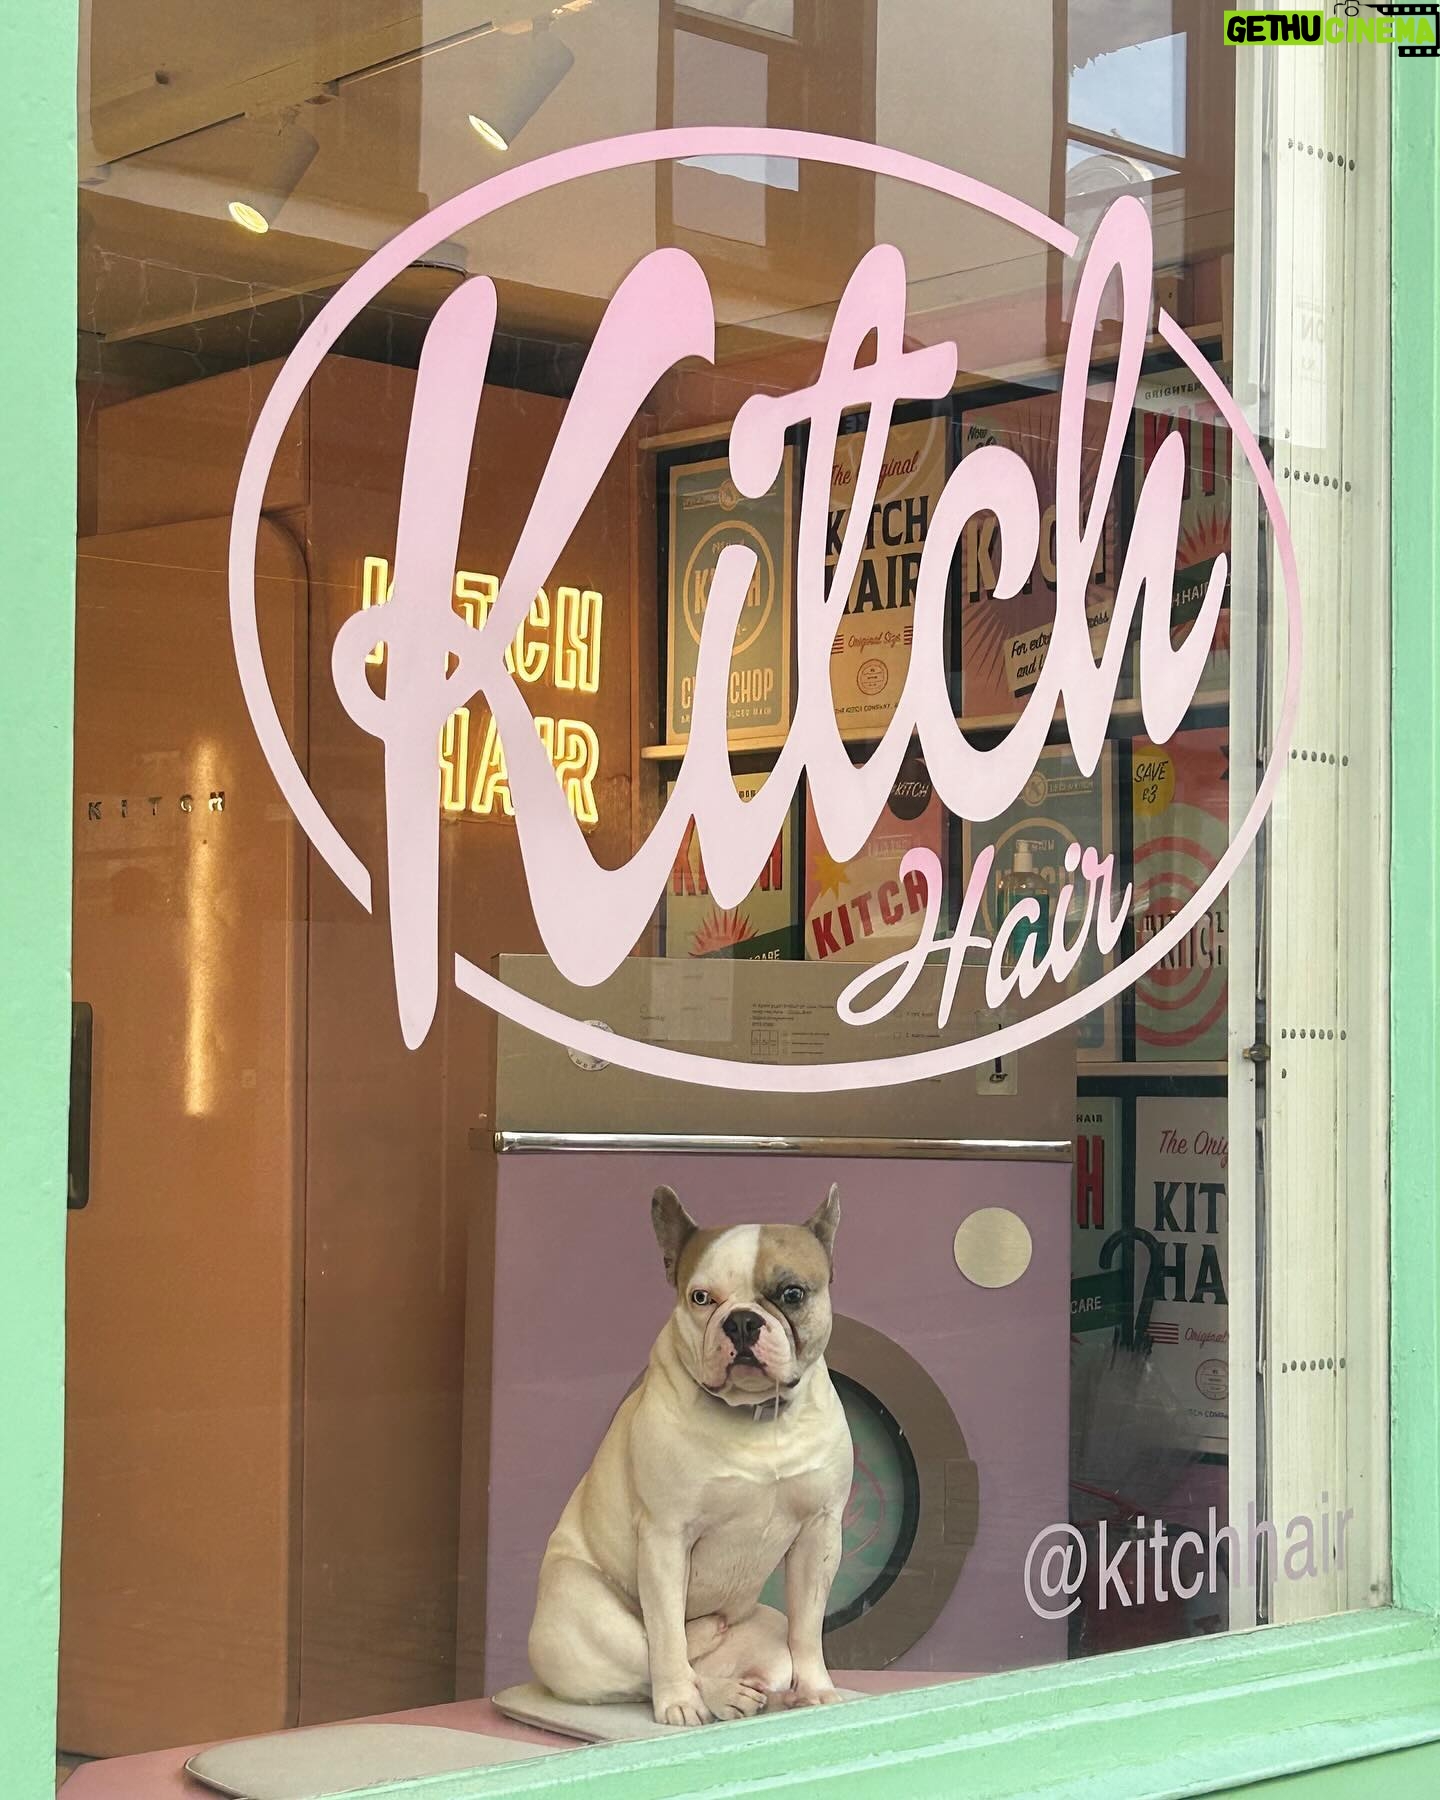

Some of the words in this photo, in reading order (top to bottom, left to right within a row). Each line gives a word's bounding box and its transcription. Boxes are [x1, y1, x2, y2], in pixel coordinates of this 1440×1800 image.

[831, 464, 851, 486] The
[825, 495, 930, 556] KTCH
[330, 195, 1229, 1050] Kitch
[1011, 641, 1027, 658] For
[1016, 656, 1036, 678] and
[730, 668, 774, 704] CHOP
[1134, 760, 1169, 783] SAVE
[894, 781, 930, 798] KITCH
[88, 791, 225, 820] KITCH
[811, 868, 929, 960] KITCH
[836, 842, 1133, 1029] Hair
[1160, 1129, 1188, 1155] The
[1023, 1491, 1354, 1619] @kitchhair
